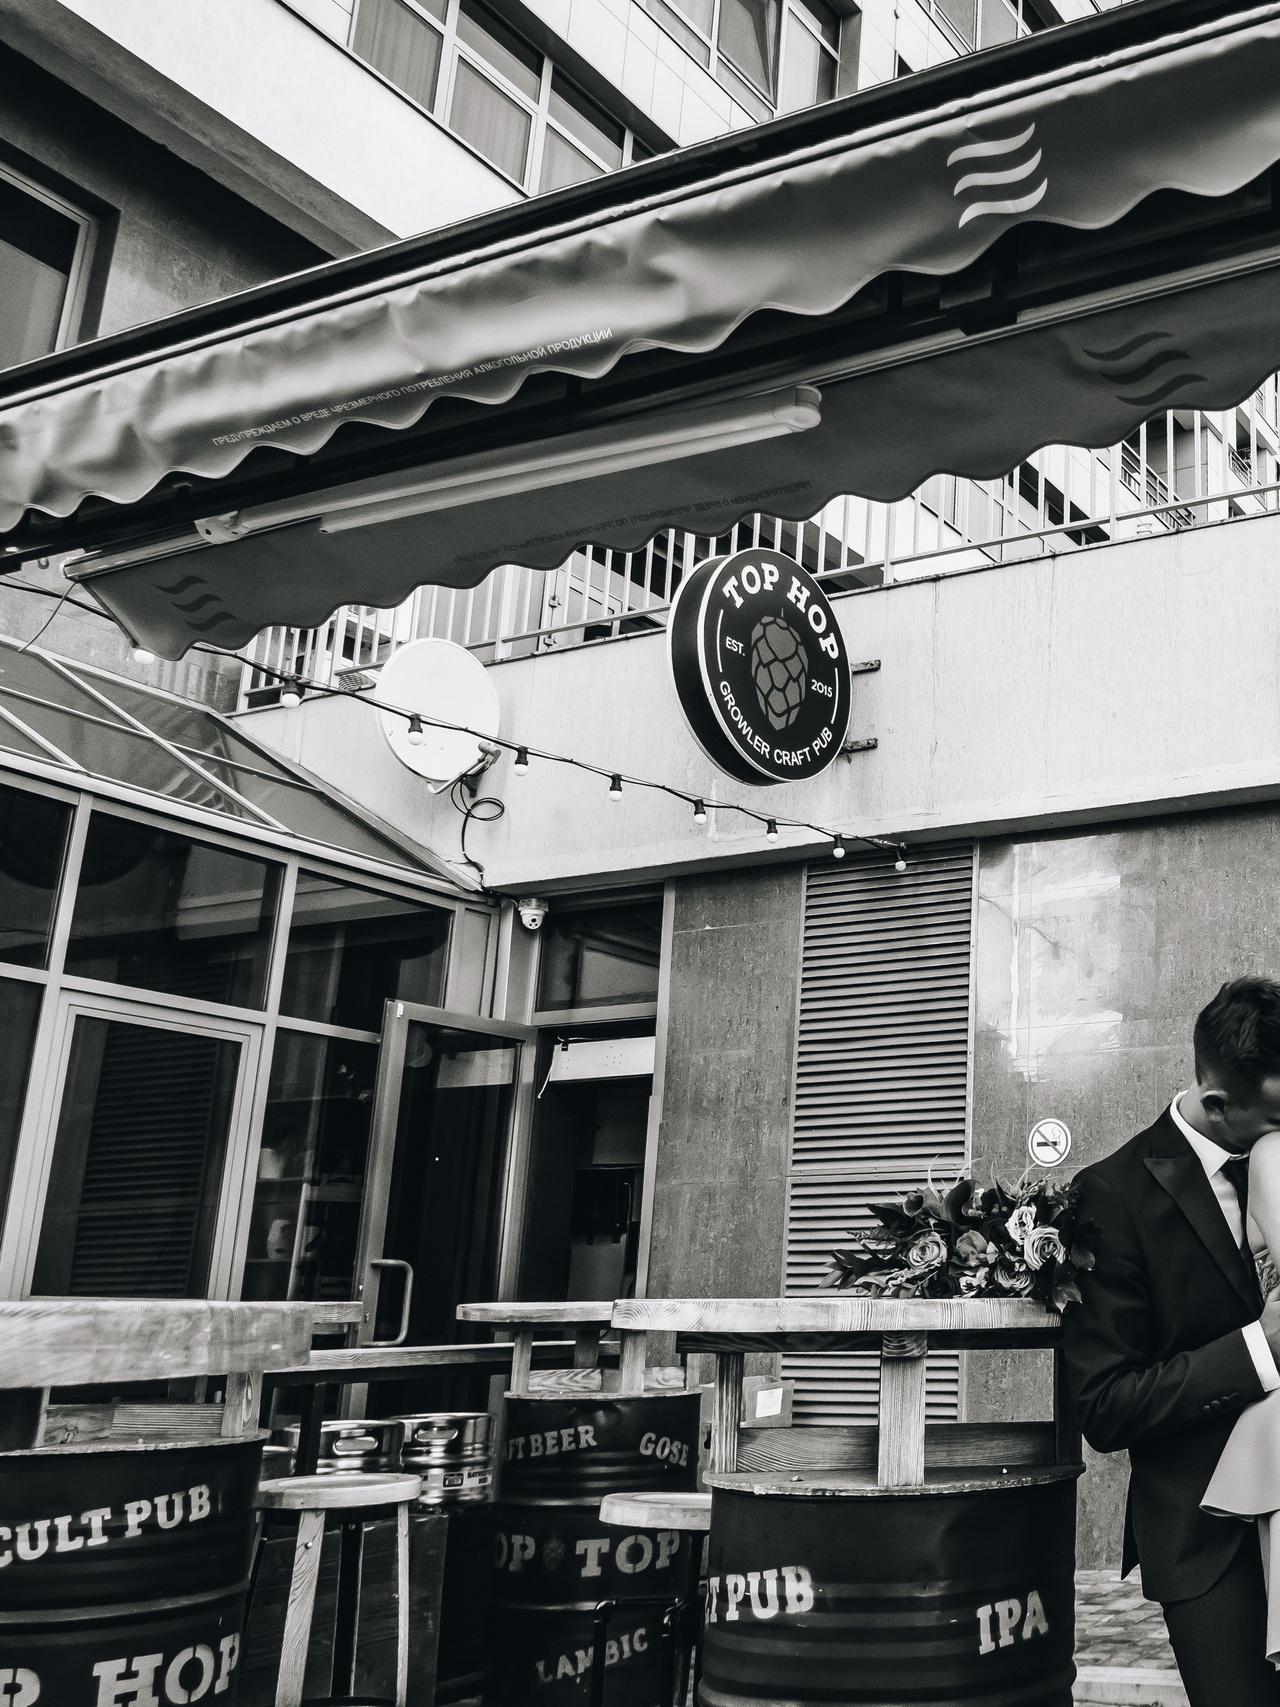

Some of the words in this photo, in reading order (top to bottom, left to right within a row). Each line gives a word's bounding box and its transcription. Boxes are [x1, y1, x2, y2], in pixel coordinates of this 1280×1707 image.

[212, 419, 291, 447] ПРЕДУПРЕЖДАЕМ
[291, 415, 301, 425] О
[300, 407, 332, 423] ВРЕДЕ
[332, 389, 401, 413] ЧРЕЗМЕРНОГО
[400, 369, 474, 395] ПОТРЕБЛЕНИЯ
[474, 346, 547, 375] АЛКОГОЛЬНОЙ
[547, 327, 613, 355] ПРОДУКЦИИ
[722, 562, 780, 608] TOP
[786, 576, 839, 659] HOP
[725, 636, 746, 656] EST.
[811, 679, 833, 698] 2015
[719, 680, 770, 759] GROWLER
[774, 747, 811, 766] CRAFT
[812, 726, 833, 756] PUB
[530, 1425, 597, 1460] BEER
[639, 1432, 690, 1467] GOSE
[124, 1484, 211, 1538] PUB
[575, 1530, 681, 1578] TOP
[704, 1577, 720, 1624] T
[726, 1565, 814, 1621] PUB
[976, 1590, 1049, 1655] IPA
[92, 1633, 240, 1707] HOP
[536, 1627, 648, 1683] LAMBIC
